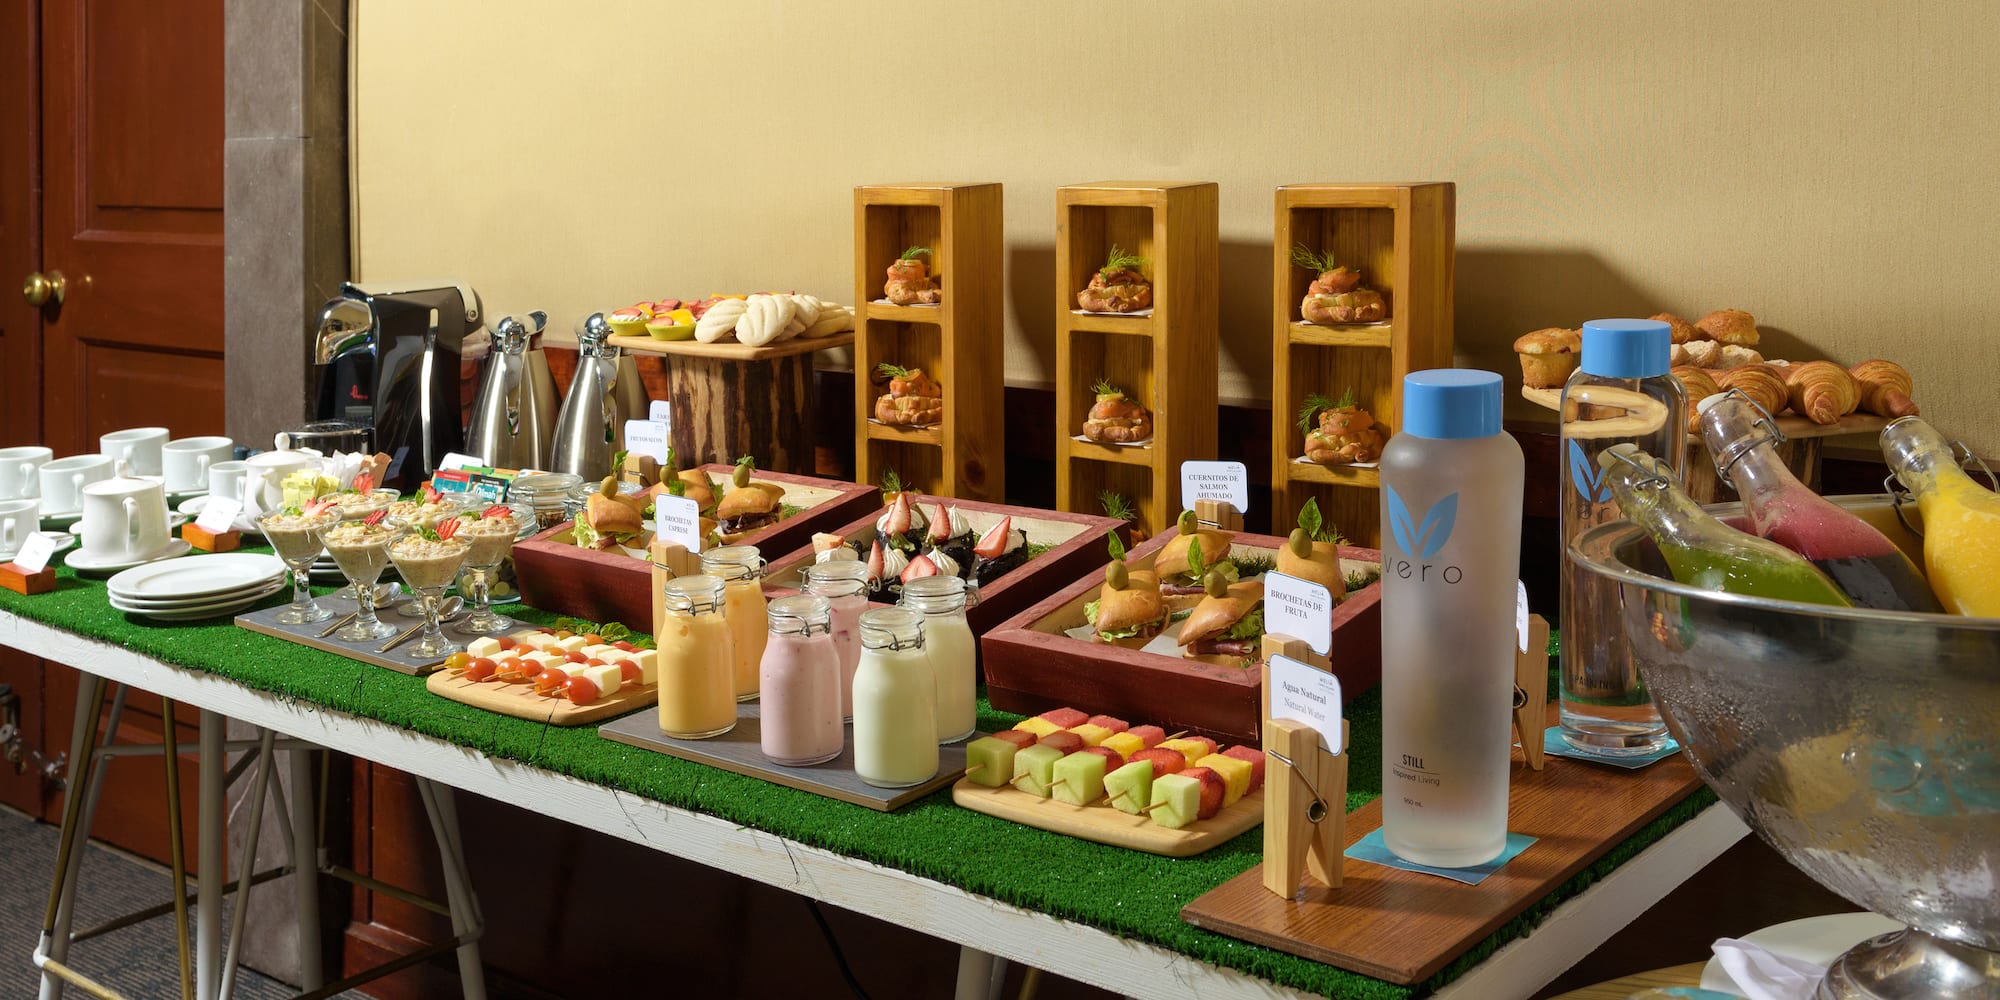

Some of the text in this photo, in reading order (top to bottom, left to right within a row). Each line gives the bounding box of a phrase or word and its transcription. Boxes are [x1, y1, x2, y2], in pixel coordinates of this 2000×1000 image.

[1188, 474, 1228, 482] CUERNITOS
[1197, 491, 1233, 499] AHUMADO
[664, 514, 693, 526] BROCHETAS
[1384, 554, 1463, 585] vero
[1271, 589, 1312, 609] BROCHETAS
[1313, 602, 1323, 613] DE
[1285, 605, 1308, 619] FRUTA
[1283, 680, 1300, 694] Agua
[1300, 687, 1327, 705] Natural
[1284, 697, 1326, 722] Natural Water
[1402, 753, 1425, 770] STILL
[1392, 767, 1441, 787] Inspired Living
